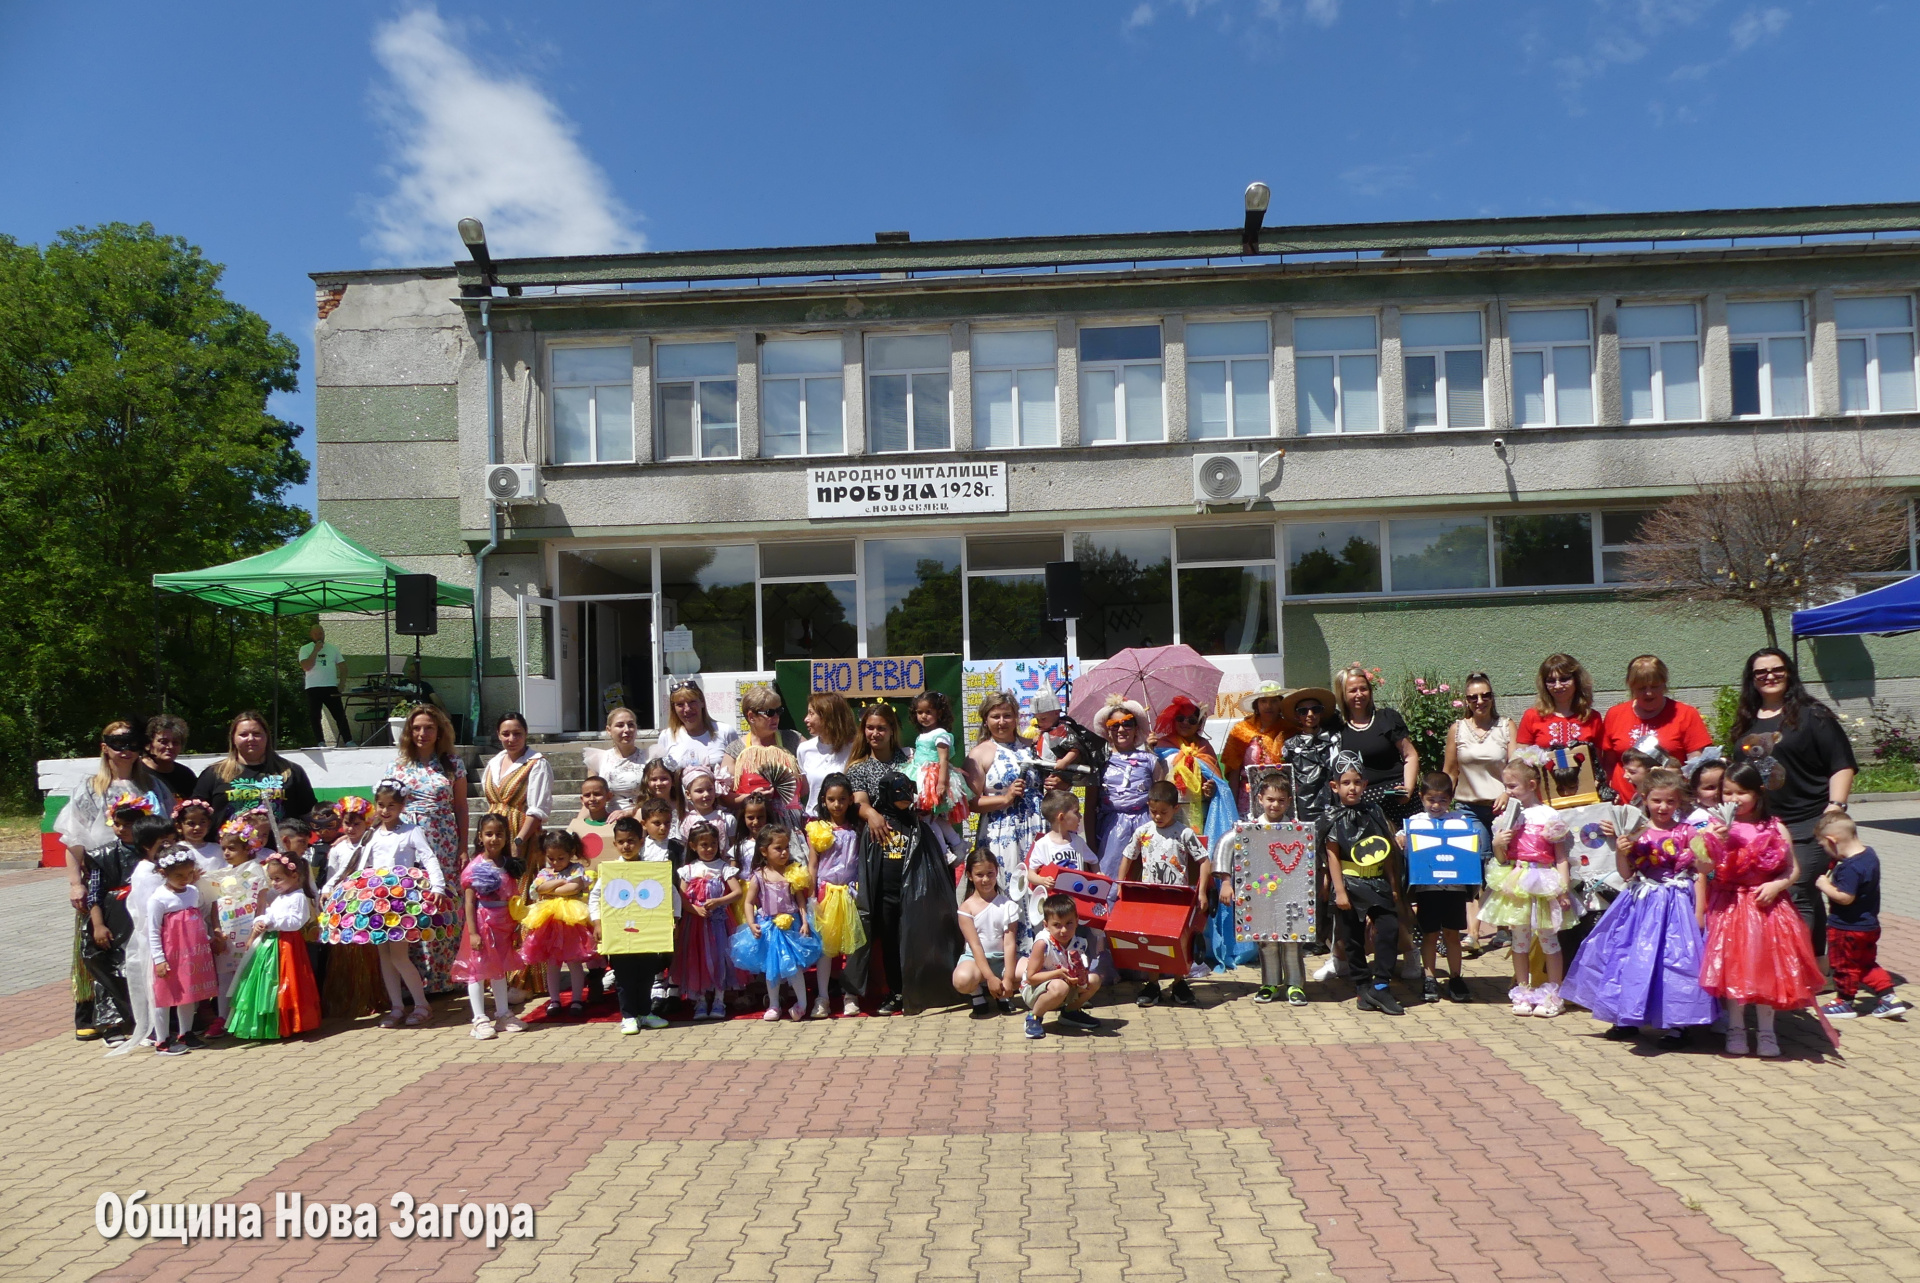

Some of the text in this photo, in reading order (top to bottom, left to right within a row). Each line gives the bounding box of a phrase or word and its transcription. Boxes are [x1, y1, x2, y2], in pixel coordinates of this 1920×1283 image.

[815, 464, 999, 484] НАРОДНО ЧИТАЛИЩЕ
[817, 481, 995, 503] ПРОБУДА 1928г.
[812, 659, 925, 693] ЕКО РЕВЮ
